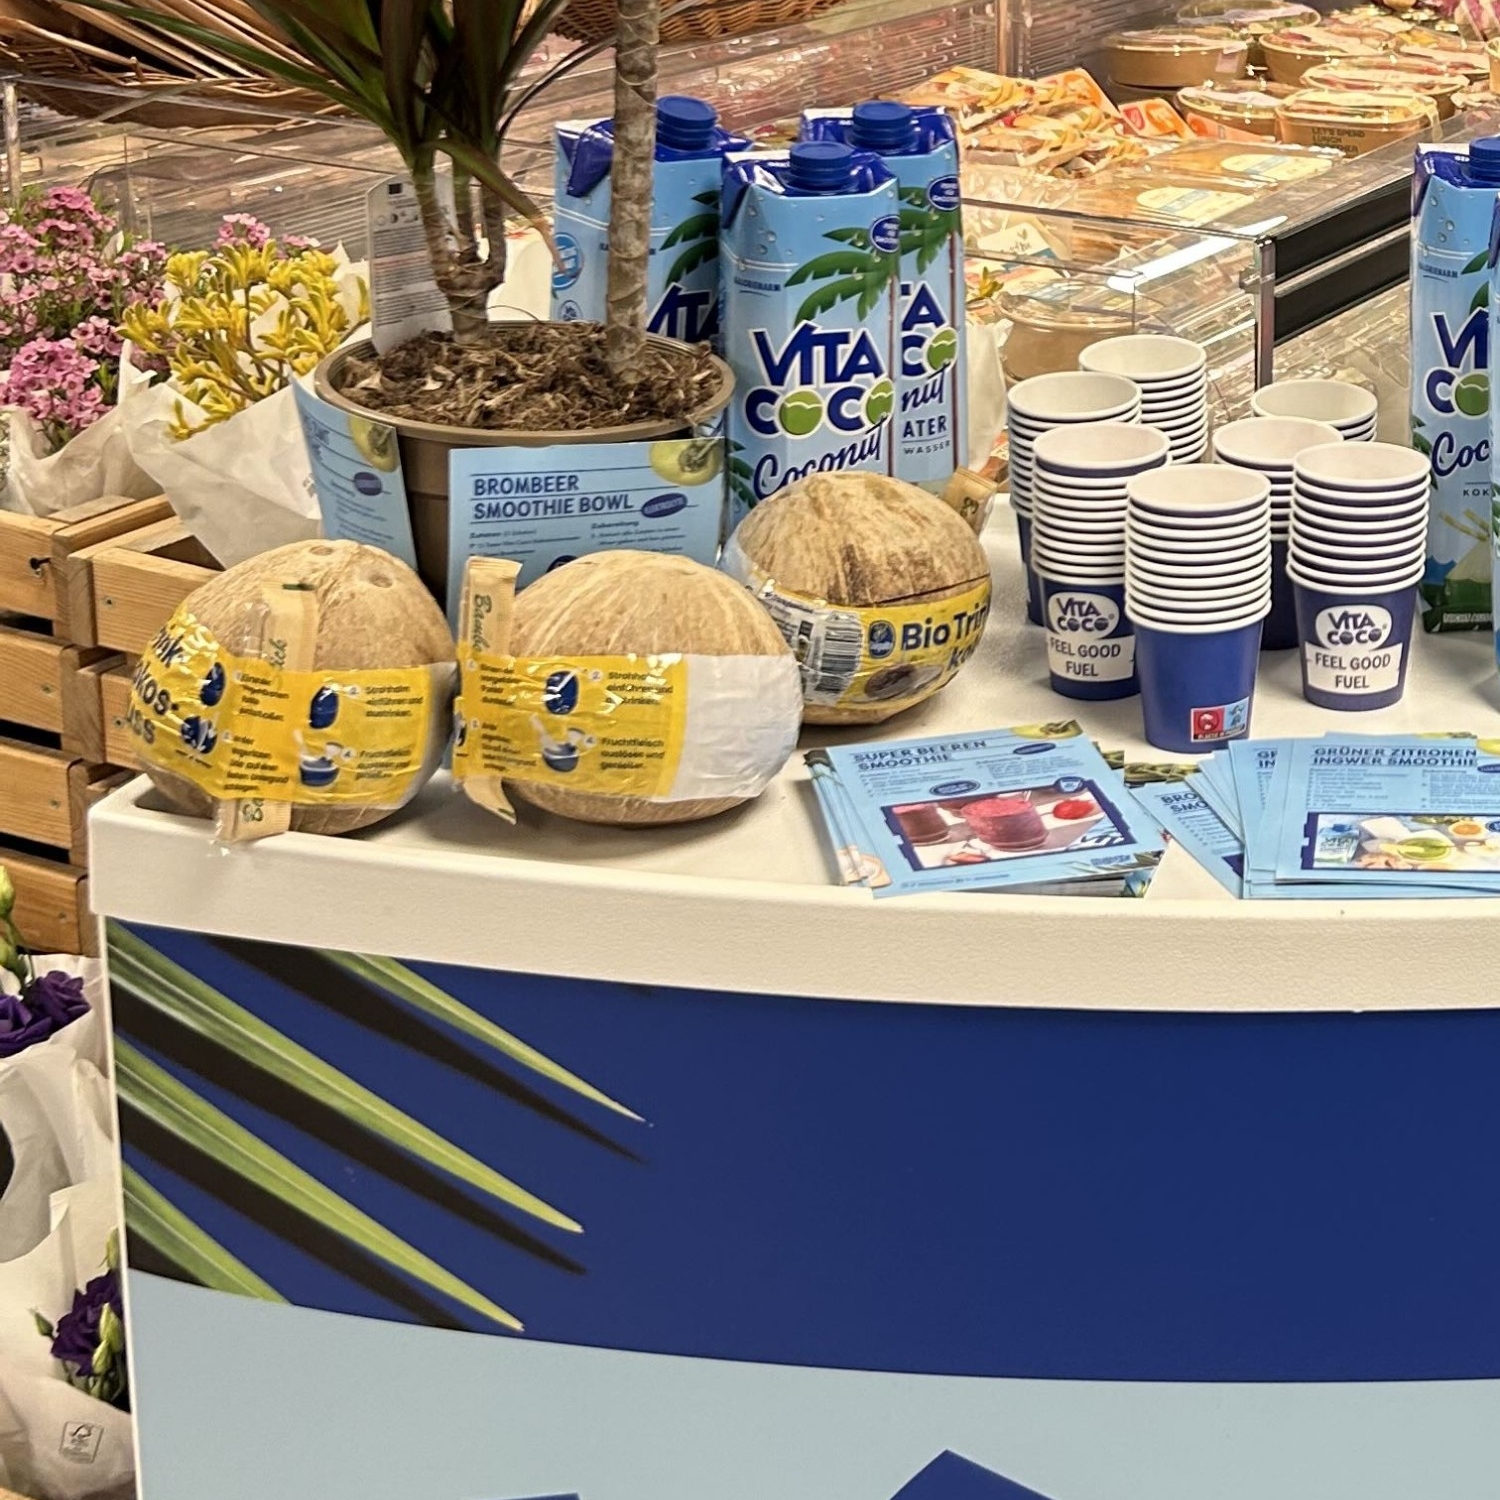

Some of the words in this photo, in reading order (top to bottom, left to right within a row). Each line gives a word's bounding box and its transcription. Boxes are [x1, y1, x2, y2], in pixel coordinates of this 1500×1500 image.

[752, 323, 884, 387] VITA
[745, 380, 894, 436] COCO
[902, 415, 948, 438] ATER
[753, 414, 889, 500] Coconut
[474, 475, 579, 497] BROMBEER
[474, 498, 574, 520] SMOOTHIE
[579, 494, 635, 514] BOWL
[1057, 596, 1099, 617] VITA
[1057, 616, 1109, 632] COCO
[1329, 610, 1374, 629] VITA
[902, 616, 949, 651] Bio
[1327, 628, 1382, 647] COCO
[1050, 638, 1076, 656] FEEL
[1078, 643, 1121, 659] GOOD
[1066, 660, 1099, 678] FUEL
[1315, 652, 1347, 670] FEEL
[1350, 653, 1391, 671] GOOD
[1335, 673, 1370, 690] FUEL
[854, 747, 914, 762] SUPER
[917, 739, 987, 756] BEEREN
[1314, 745, 1384, 757] GRÜNER
[1391, 748, 1477, 758] ZITRONEN
[858, 753, 951, 771] SMOOTHIE
[1313, 757, 1385, 767] INGWER
[1387, 757, 1478, 768] SMOOTHIE
